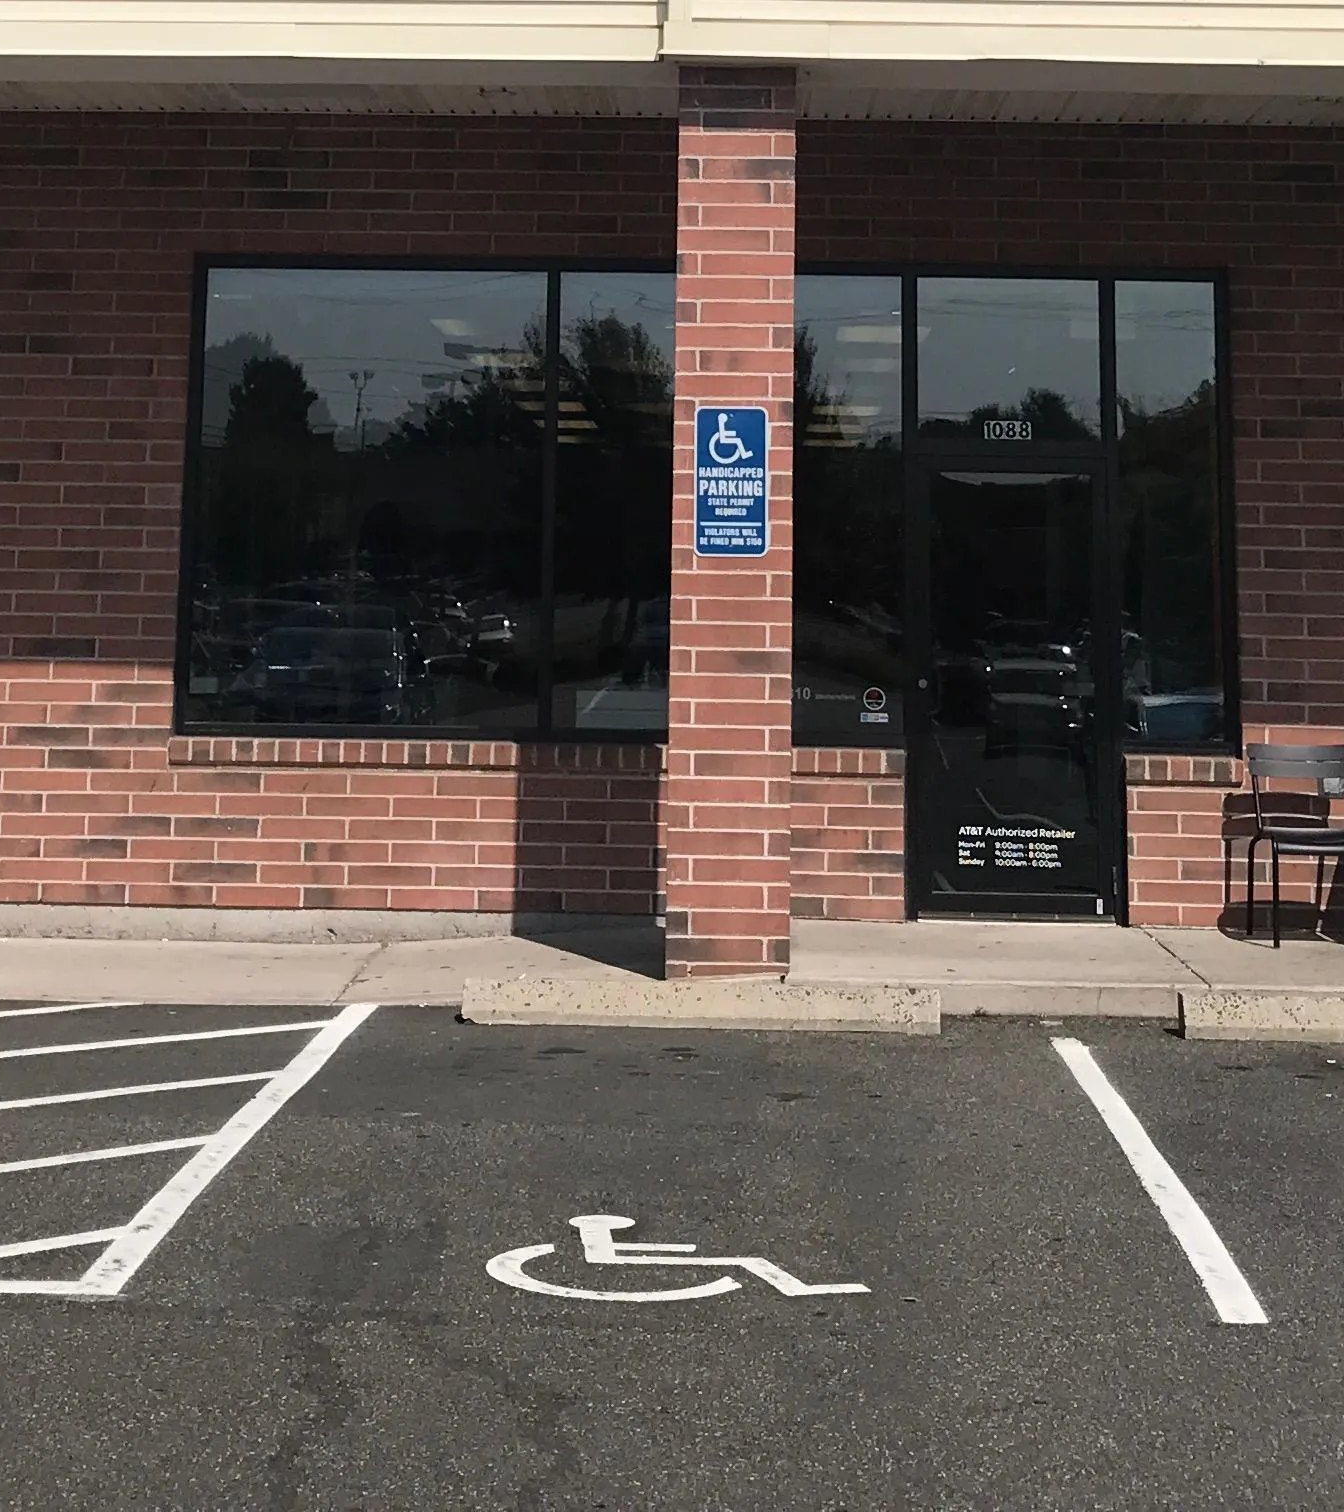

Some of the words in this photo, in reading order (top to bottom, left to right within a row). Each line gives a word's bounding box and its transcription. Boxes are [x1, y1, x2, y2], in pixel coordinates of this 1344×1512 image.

[984, 420, 1031, 439] 1088
[699, 467, 763, 478] HANDICAPPED
[699, 480, 763, 496] PARKING
[707, 498, 728, 506] STATE
[958, 826, 984, 836] AT&T
[984, 826, 1039, 838] Authorized
[1039, 828, 1076, 839] Retailer
[958, 840, 986, 849] Mon-Fri
[958, 858, 986, 867] Sunday
[994, 858, 1028, 867] 10:00am
